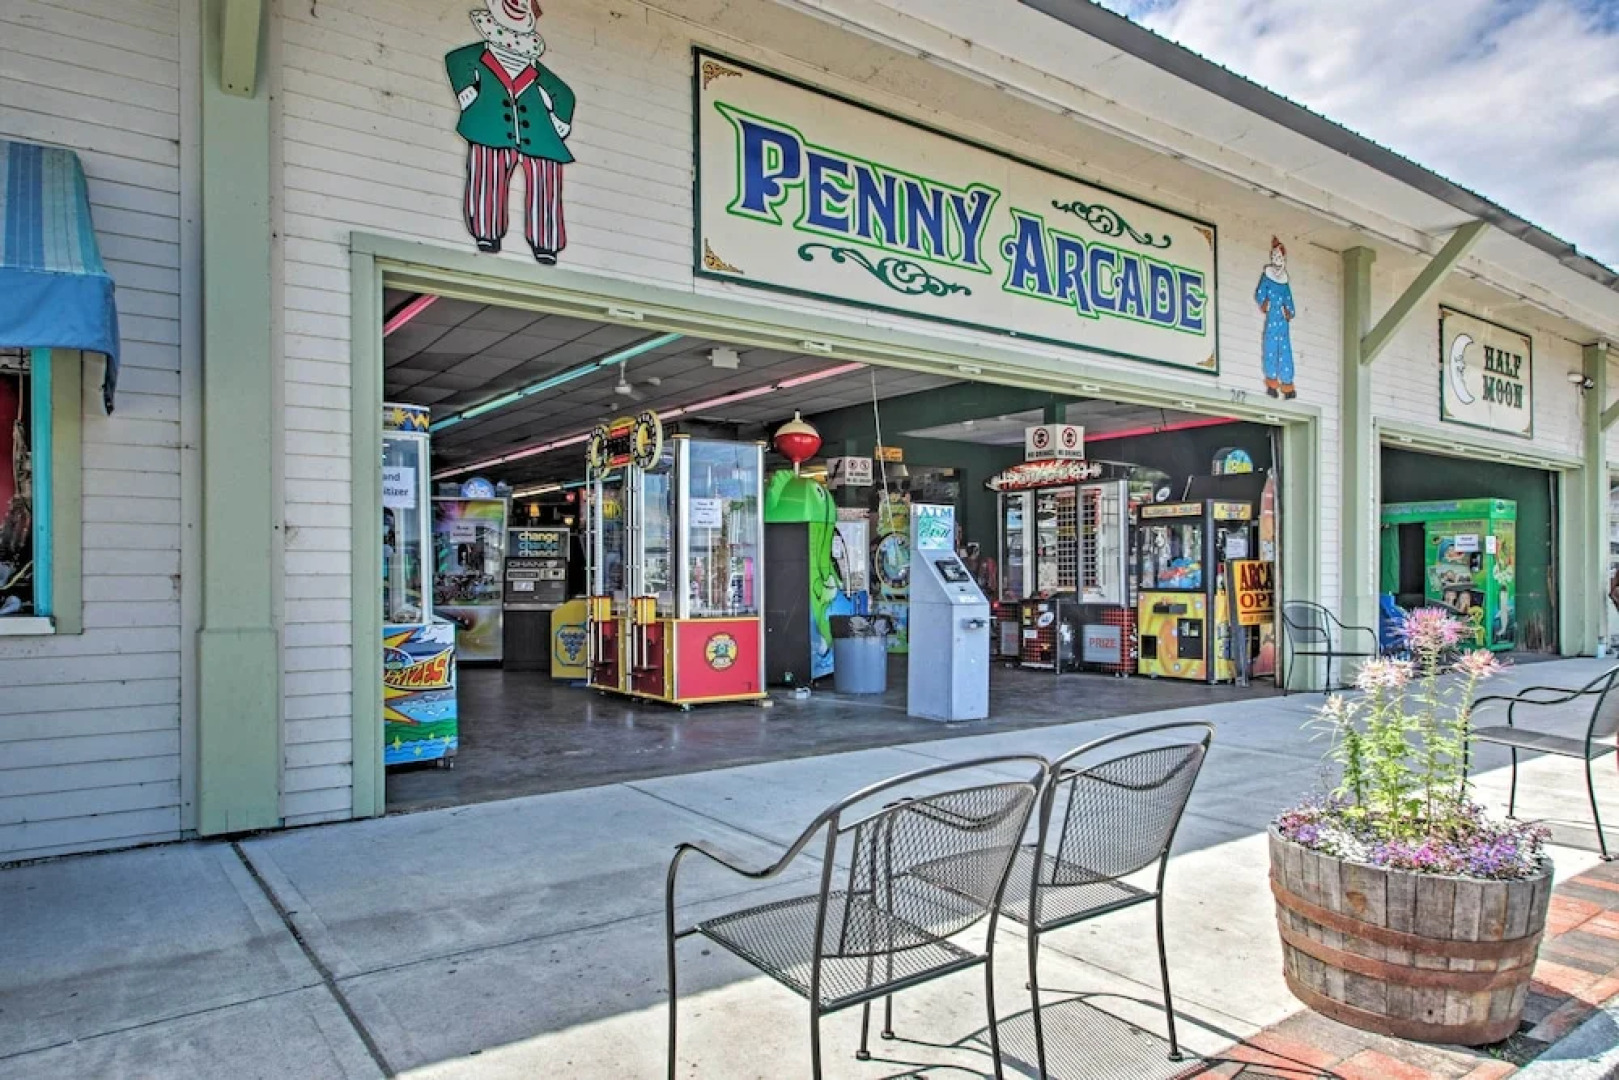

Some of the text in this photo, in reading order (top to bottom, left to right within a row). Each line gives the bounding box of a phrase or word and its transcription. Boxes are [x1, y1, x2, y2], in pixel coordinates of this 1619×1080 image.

[714, 103, 1206, 335] PENNY ARCADE
[1483, 344, 1523, 380] HALF
[1482, 374, 1524, 409] MOON
[919, 506, 953, 519] ATM
[517, 530, 559, 543] change
[517, 540, 559, 551] change
[1089, 637, 1116, 648] PRIZE
